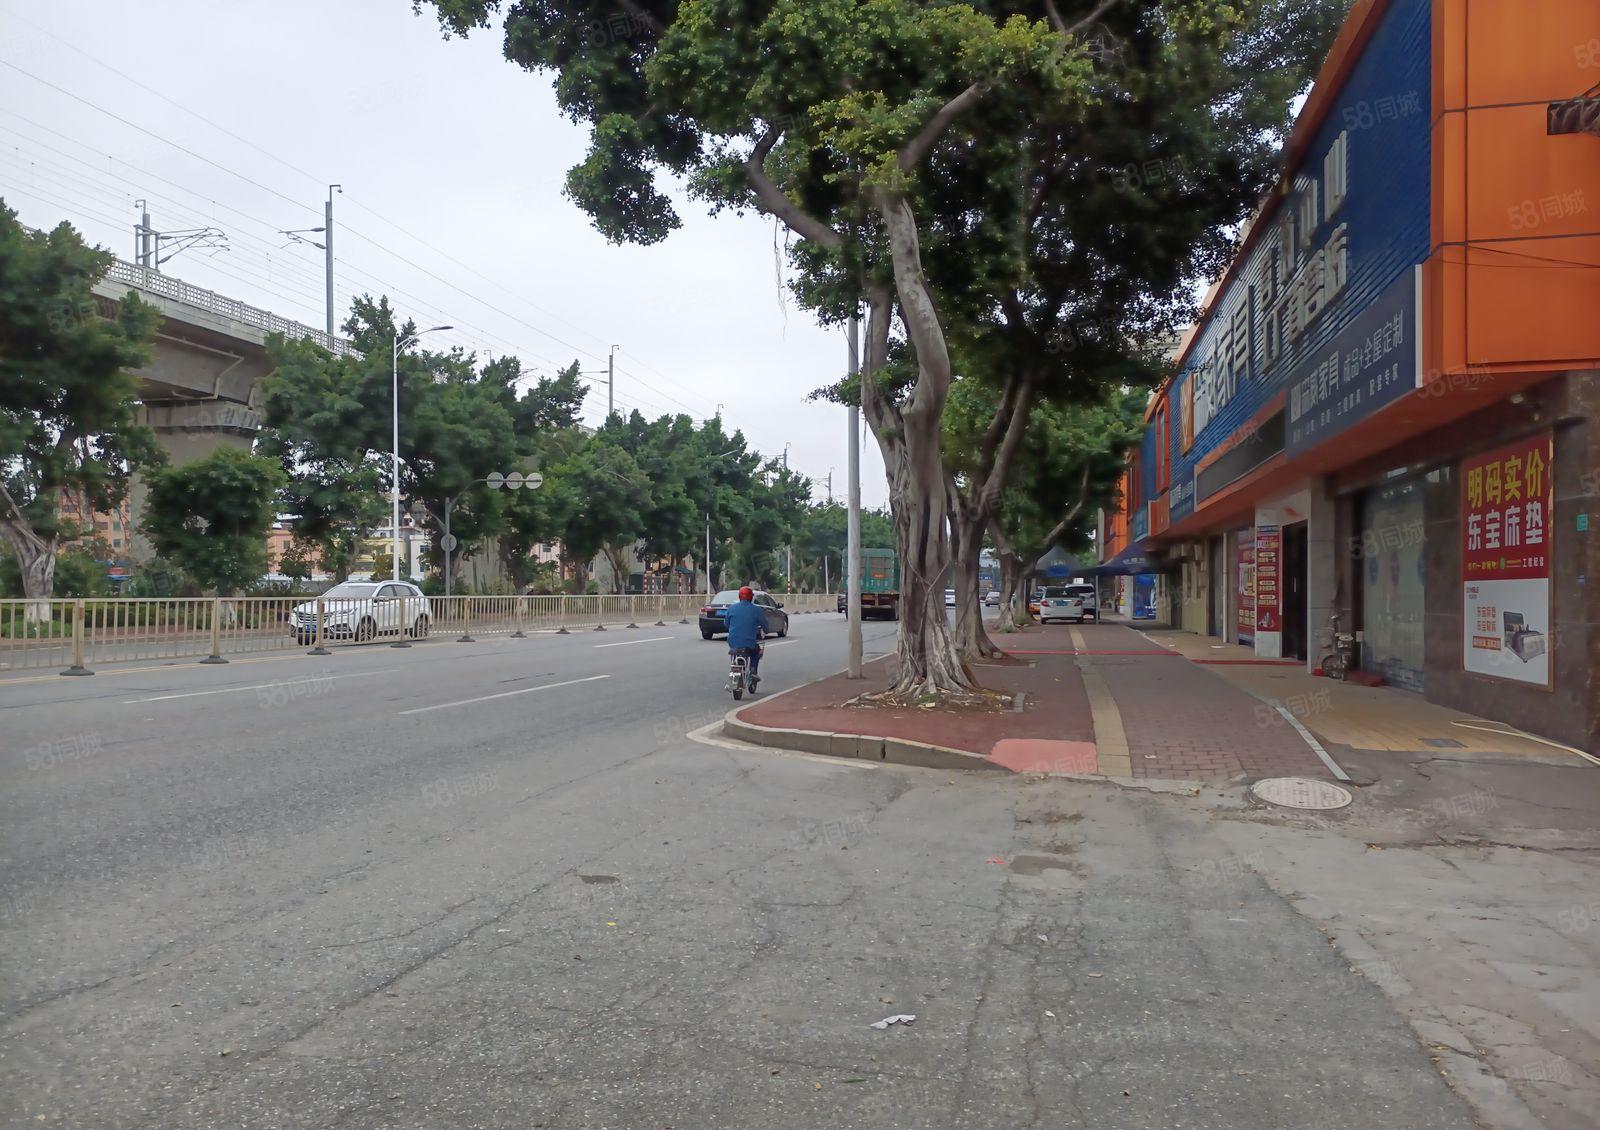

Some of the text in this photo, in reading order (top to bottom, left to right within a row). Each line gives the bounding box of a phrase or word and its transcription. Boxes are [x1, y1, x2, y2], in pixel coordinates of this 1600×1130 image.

[1467, 449, 1544, 509] 明码实价
[1467, 501, 1543, 551] 东宝床垫
